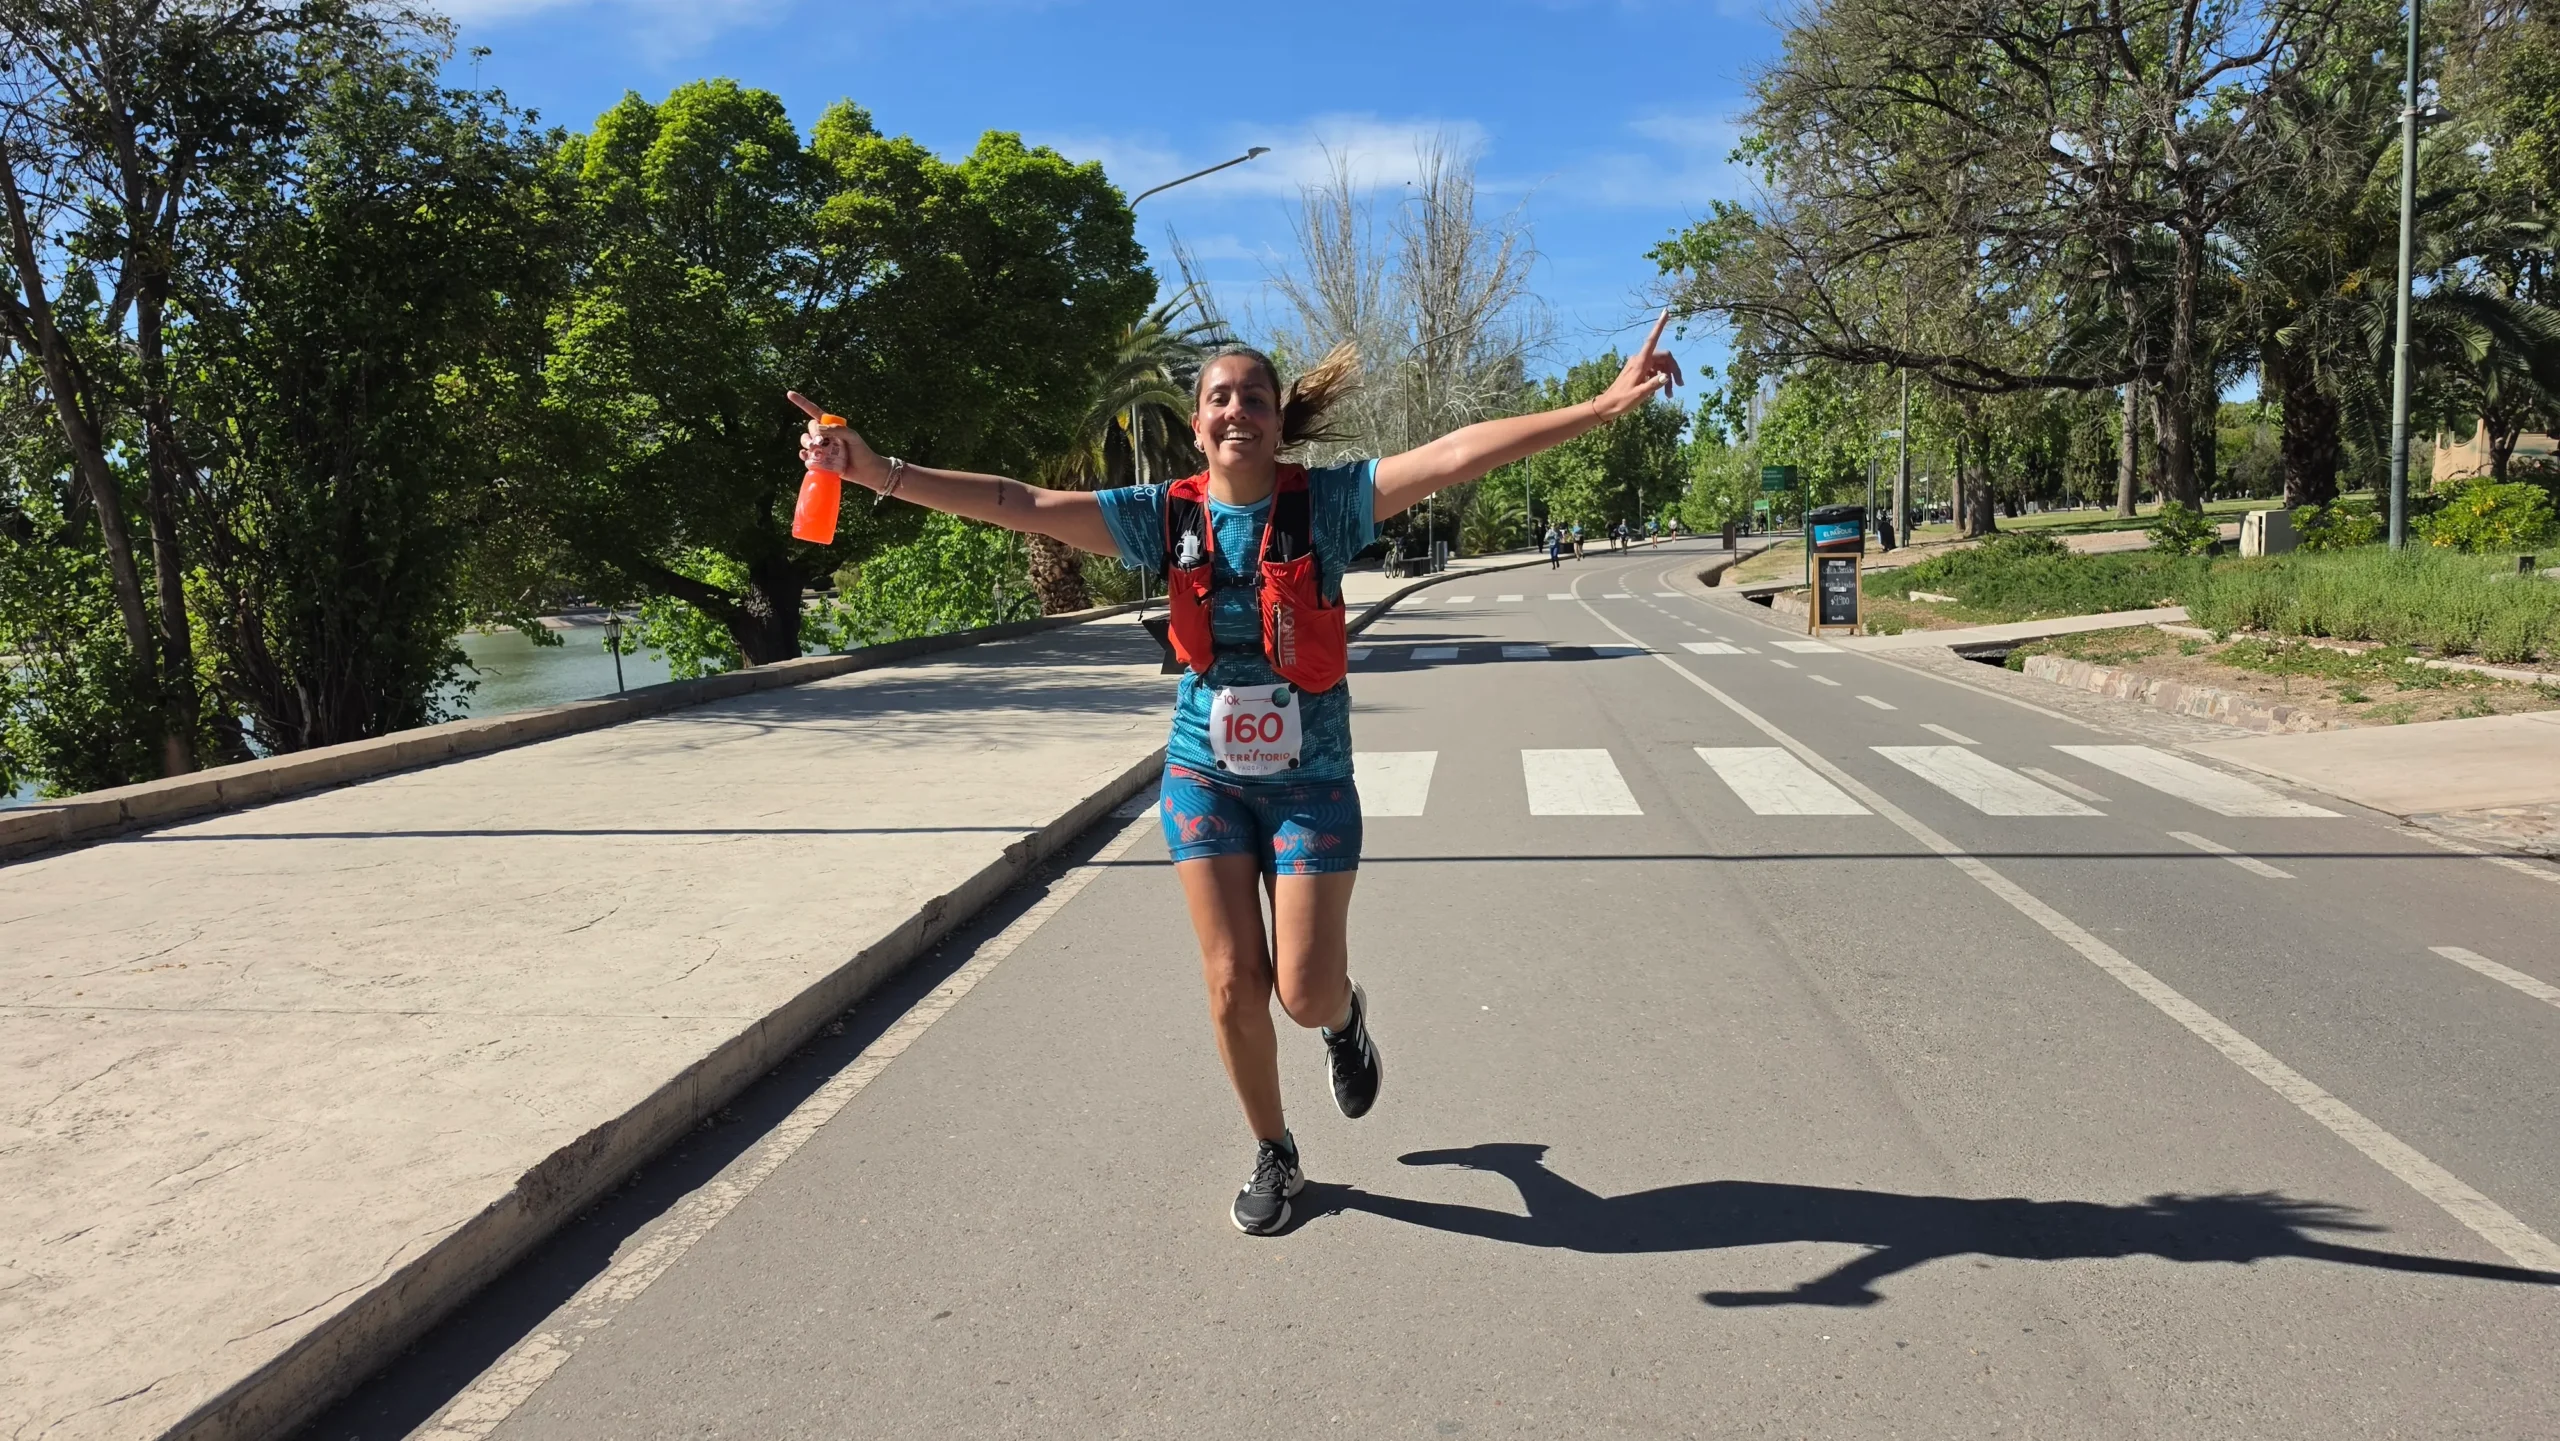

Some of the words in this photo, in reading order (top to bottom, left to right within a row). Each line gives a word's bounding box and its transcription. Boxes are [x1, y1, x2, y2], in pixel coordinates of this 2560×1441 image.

[1829, 528, 1853, 537] PARQUE
[1283, 603, 1296, 666] AONIJIE
[1223, 695, 1241, 706] 10k
[1222, 712, 1284, 743] 160
